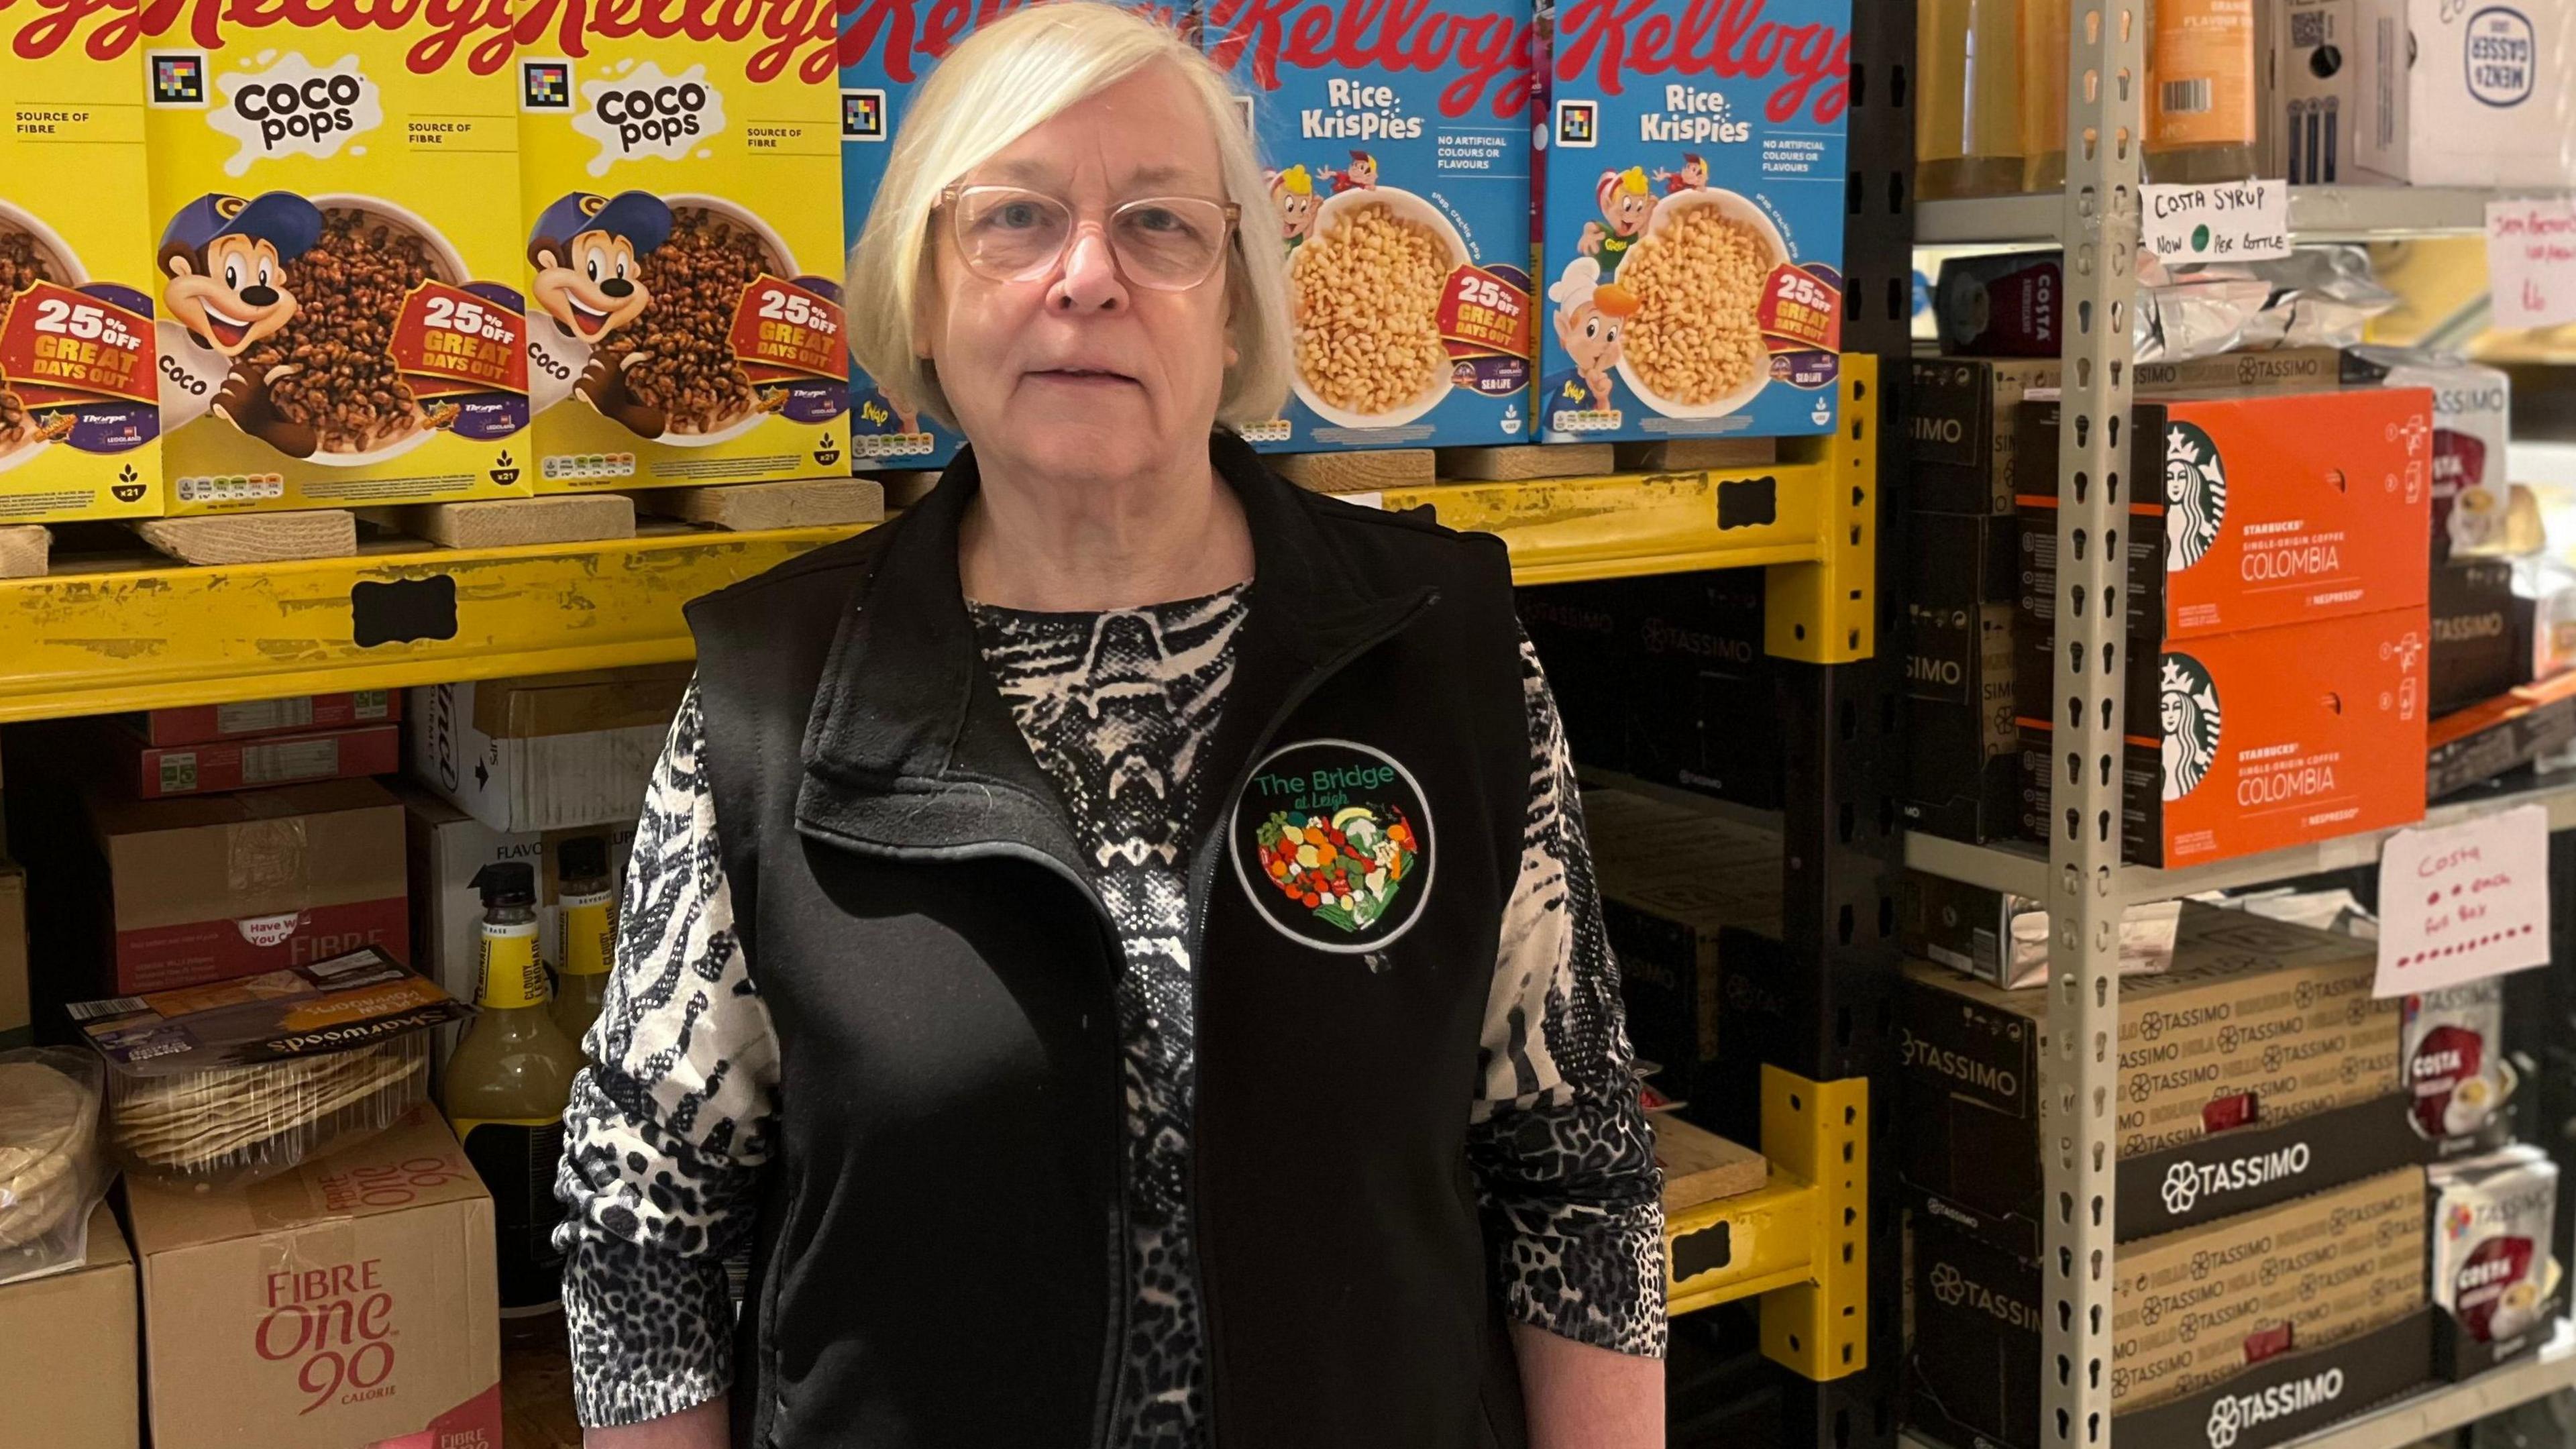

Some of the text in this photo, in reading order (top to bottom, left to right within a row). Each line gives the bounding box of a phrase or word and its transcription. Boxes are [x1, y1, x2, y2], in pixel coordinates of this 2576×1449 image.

[2472, 38, 2528, 62] GASSER
[1328, 78, 1392, 109] Rice
[1666, 85, 1723, 113] Rice
[15, 112, 89, 122] SOURCE OF
[16, 123, 56, 134] FIBRE
[260, 106, 354, 150] pops
[408, 122, 472, 132] SOURCE OF
[1301, 109, 1421, 140] Krispies
[1640, 114, 1750, 144] Krispies
[409, 134, 442, 144] FIBRE
[620, 113, 700, 152] pops
[747, 128, 802, 138] SOURCE OF
[747, 139, 777, 148] FIBRE
[1438, 137, 1507, 146] NO ARTIFICIAL
[1764, 140, 1825, 150] NO ARTIFICIAL
[1438, 148, 1500, 158] COLOURS OR
[1438, 160, 1489, 169] FLAVOURS
[1763, 152, 1818, 161] COLOURS OR
[1763, 163, 1809, 172] FLAVOURS
[2155, 186, 2265, 219] COSTA SYRUP
[2214, 235, 2233, 254] PER
[2243, 233, 2284, 250] BOTTLE
[1457, 303, 1517, 333] GREAT
[1497, 300, 1521, 317] OFF
[1776, 300, 1830, 329] GREAT
[1811, 297, 1832, 314] OFF
[2036, 274, 2051, 341] COSTA
[481, 325, 515, 344] OFF
[759, 321, 835, 354] GREAT
[808, 316, 837, 334] OFF
[1456, 321, 1487, 339] DAYS
[1775, 317, 1802, 335] DAYS
[102, 329, 142, 350] OFF
[424, 329, 513, 366] GREAT
[757, 341, 796, 360] DAYS
[35, 335, 138, 374] GREAT
[422, 352, 469, 372] DAYS
[33, 360, 86, 380] DAYS
[2258, 360, 2317, 378] TASSIMO
[497, 472, 513, 481] x21
[120, 489, 138, 498] x21
[2243, 521, 2301, 536] STARBUCKS
[2312, 532, 2344, 543] COFFEE
[2241, 545, 2339, 581] COLOMBIA
[2432, 612, 2503, 641] TASSIMO
[2239, 743, 2296, 761] STARBUCKS
[2306, 753, 2339, 765] COFFEE
[1254, 765, 1395, 796] The Bridge
[2237, 766, 2334, 805] COLOMBIA
[1295, 790, 1350, 810] at Leigh
[2418, 847, 2480, 877] Costa
[251, 919, 296, 933] Have W
[251, 935, 276, 944] You
[599, 932, 613, 965] CLOUDY
[478, 939, 487, 998] LEMONADE
[531, 939, 543, 998] LEMONADE
[522, 965, 534, 1000] CLOUDY
[2162, 1003, 2230, 1031] TASSIMO
[2239, 1016, 2303, 1041] TASSIMO
[1915, 1039, 2017, 1096] TASSIMO
[2151, 1034, 2346, 1093] TASSIMO TASSIMO
[2413, 1050, 2462, 1077] COSTA
[401, 1158, 470, 1187] 90
[2198, 1142, 2310, 1195] TASSIMO
[318, 1174, 361, 1212] FIBRE
[2210, 1195, 2403, 1268] TASSIMO TASSIMO
[268, 1258, 382, 1307] FIBRE
[2161, 1243, 2339, 1311] TASSIMO TASSIMO
[2458, 1258, 2511, 1289] COSTA
[2199, 1258, 2375, 1330] TASSIMO TASSIMO
[298, 1342, 394, 1415] 90
[2129, 1350, 2193, 1386] TASSIMO
[341, 1385, 396, 1405] CALORIE
[2238, 1368, 2344, 1427] TASSIMO
[441, 1428, 485, 1448] FIBRE
